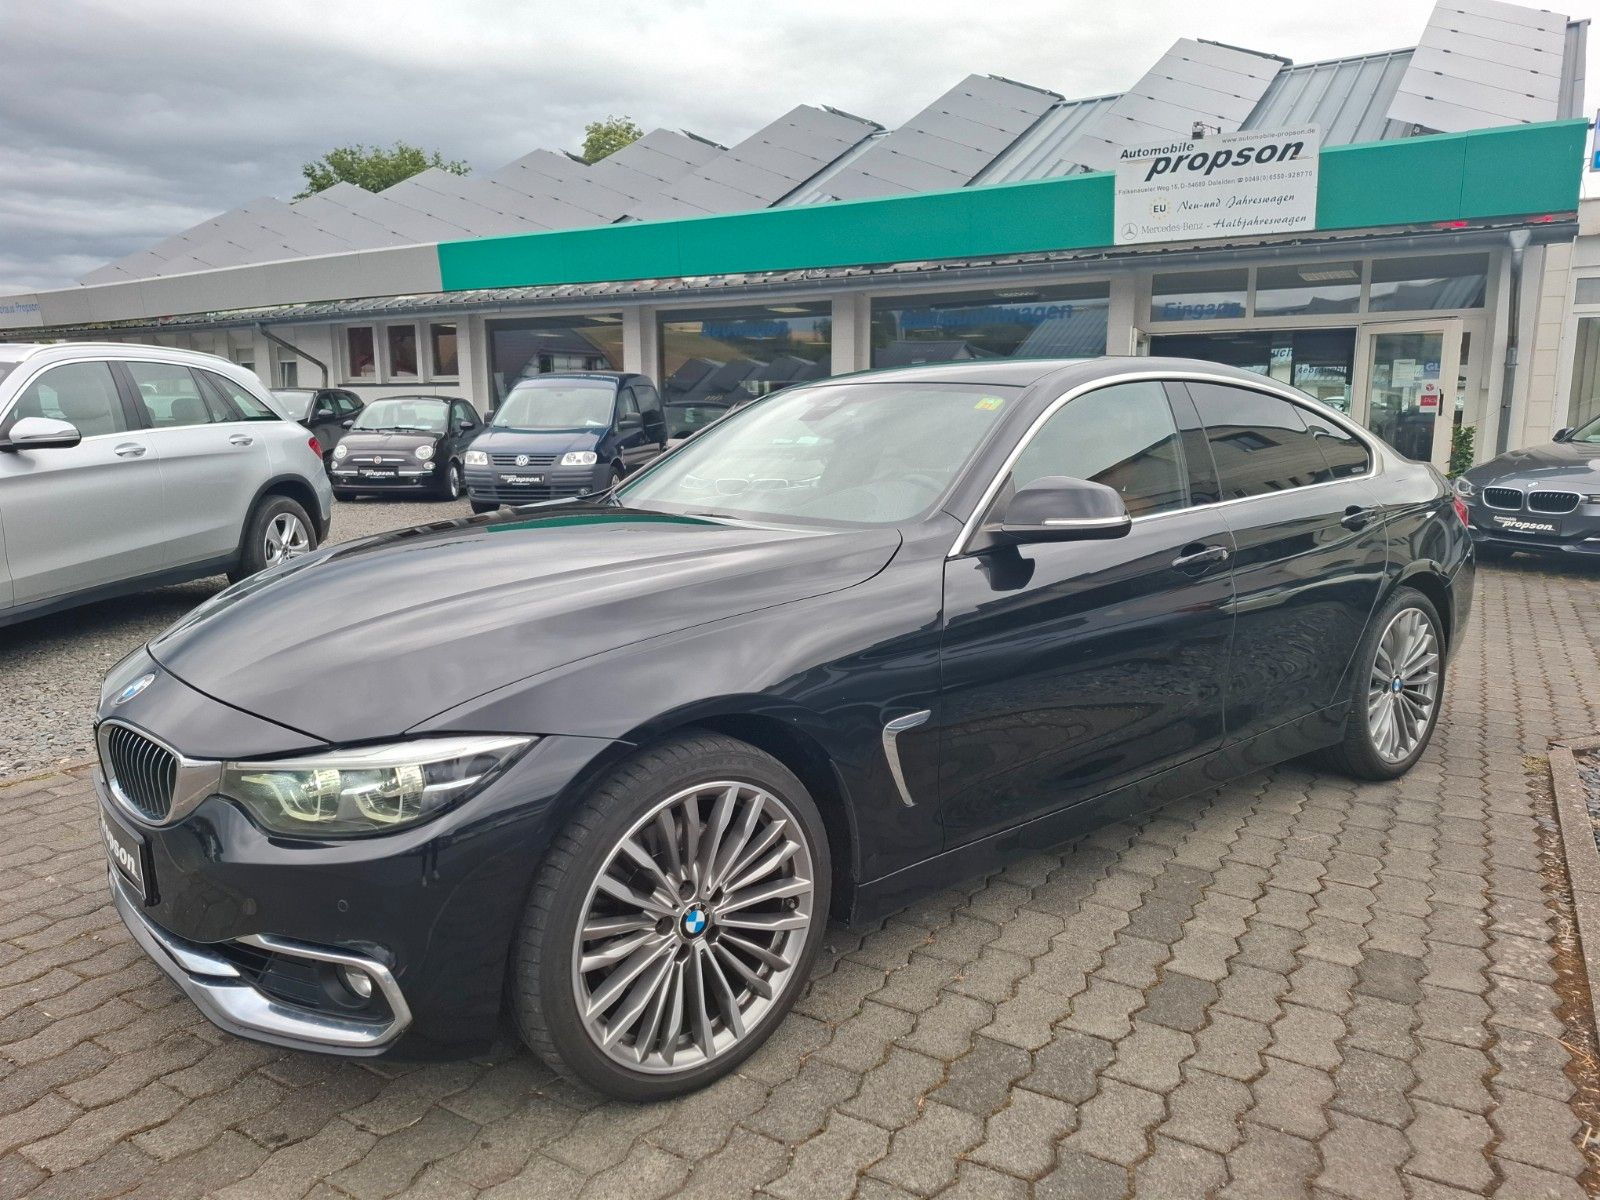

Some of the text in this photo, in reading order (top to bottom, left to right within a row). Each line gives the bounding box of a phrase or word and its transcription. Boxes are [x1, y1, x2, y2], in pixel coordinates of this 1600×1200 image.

[1221, 127, 1316, 144] www.automobile-propson.de
[1120, 141, 1195, 160] Automobile
[1143, 140, 1305, 183] propson
[1156, 184, 1170, 192] Weg
[1153, 204, 1167, 213] EU
[1225, 193, 1296, 209] Jahreswagen
[1212, 214, 1307, 230] Halbjahreswagen
[1424, 362, 1440, 371] GL
